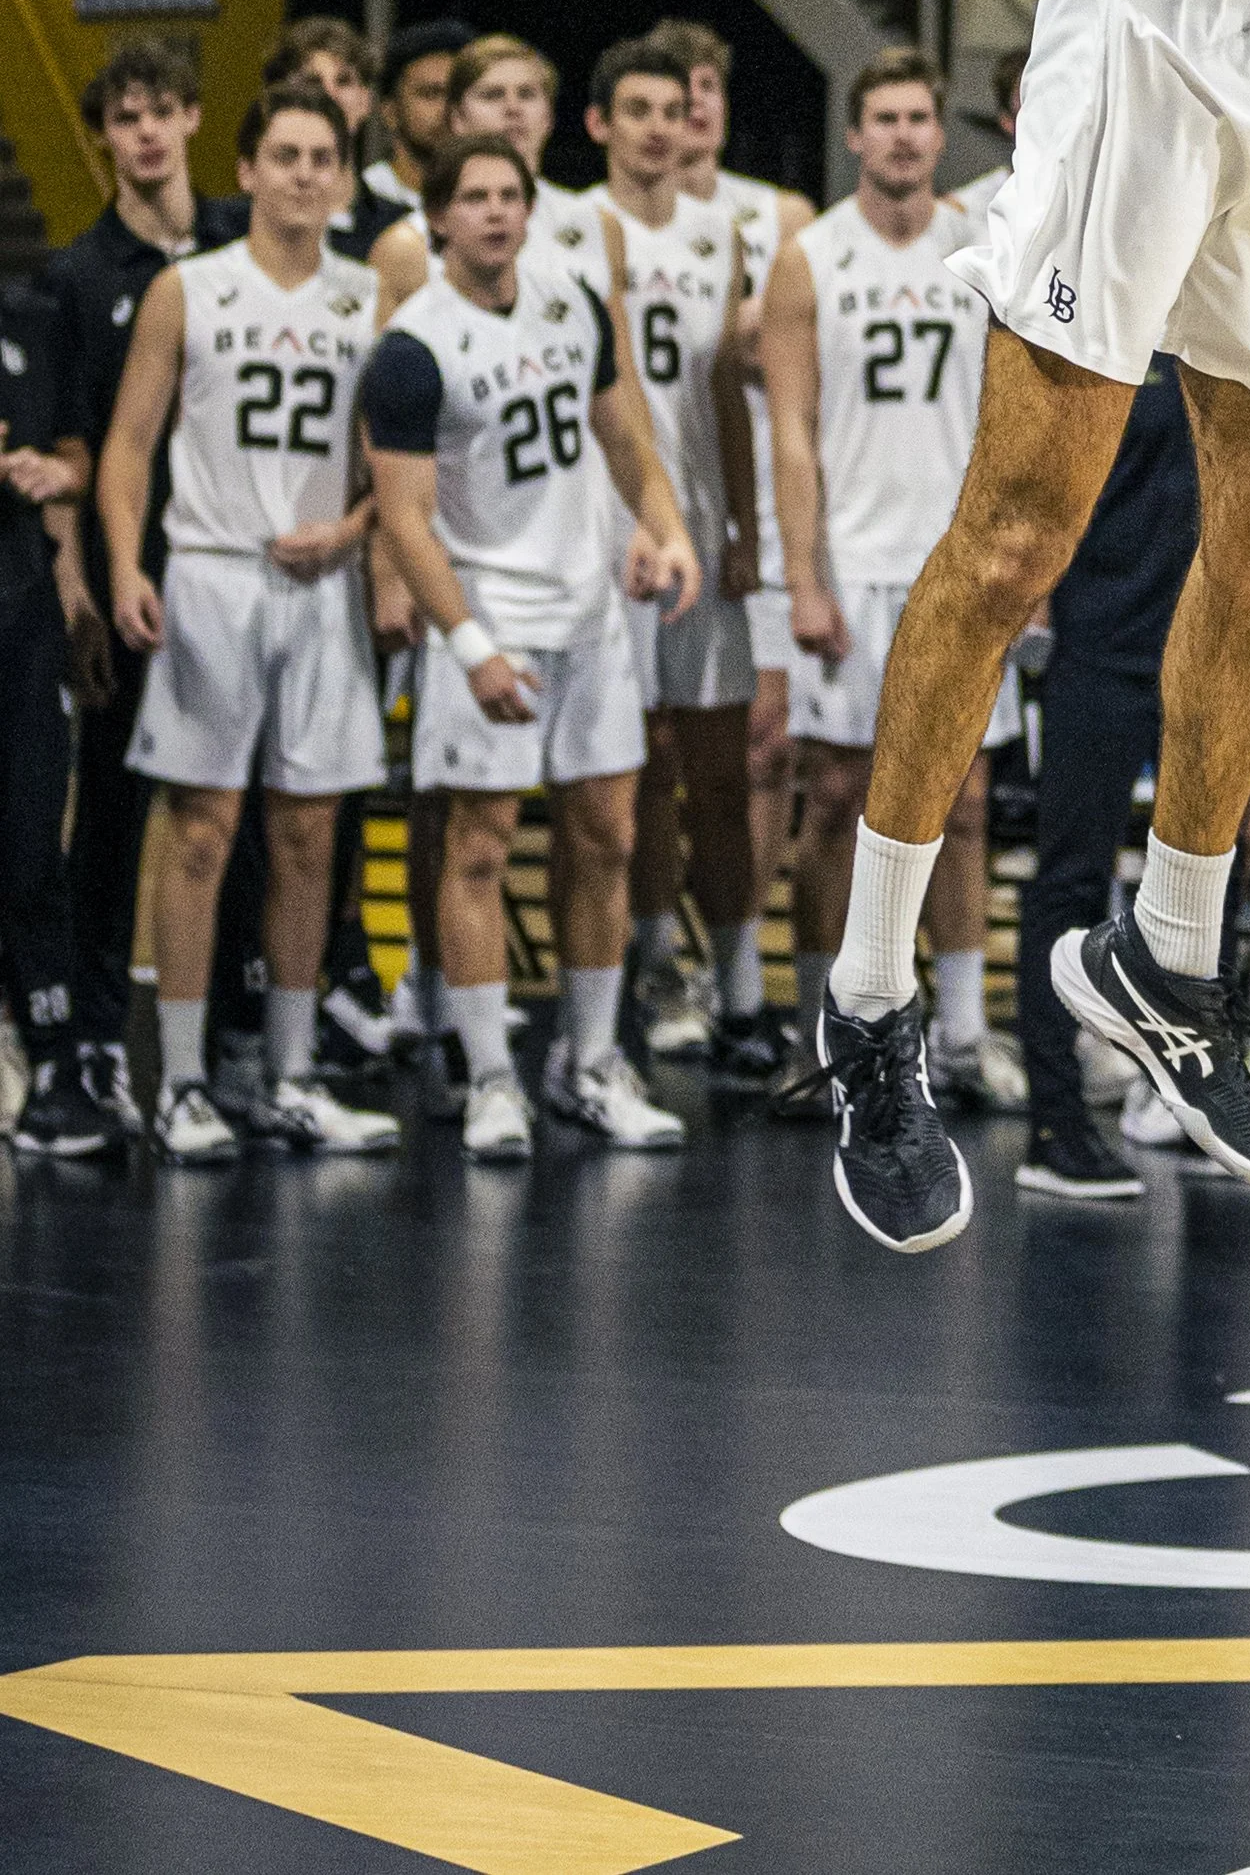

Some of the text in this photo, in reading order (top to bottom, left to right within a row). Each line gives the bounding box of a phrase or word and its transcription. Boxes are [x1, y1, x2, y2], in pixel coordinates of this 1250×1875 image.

[839, 285, 988, 317] BEACH
[214, 325, 358, 361] BEACH
[472, 338, 586, 404] BEACH
[643, 303, 680, 383] 6
[864, 319, 954, 404] 27
[237, 361, 336, 457] 22
[502, 381, 582, 486] 26
